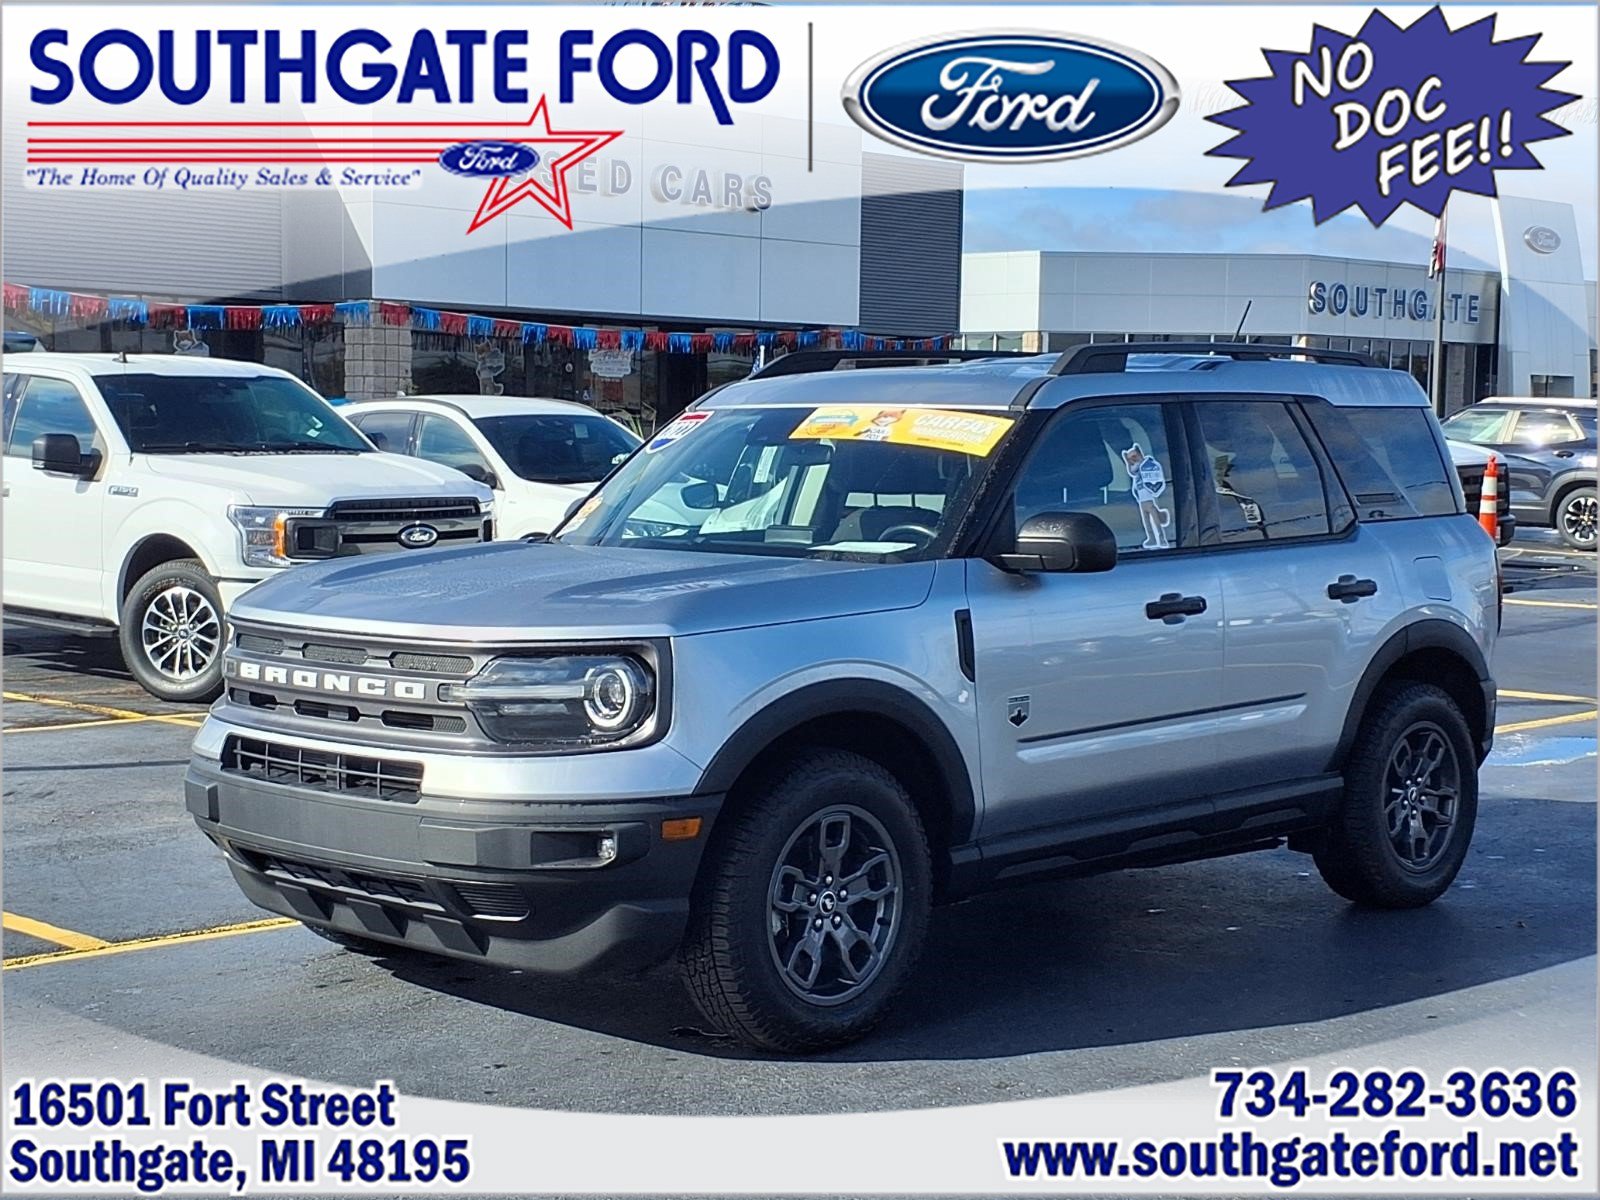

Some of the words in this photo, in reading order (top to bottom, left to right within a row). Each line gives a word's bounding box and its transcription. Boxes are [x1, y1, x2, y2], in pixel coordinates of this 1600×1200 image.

[508, 150, 632, 197] SED
[651, 162, 773, 212] CARS
[914, 414, 999, 434] CARFAX
[240, 662, 425, 700] BRONCO
